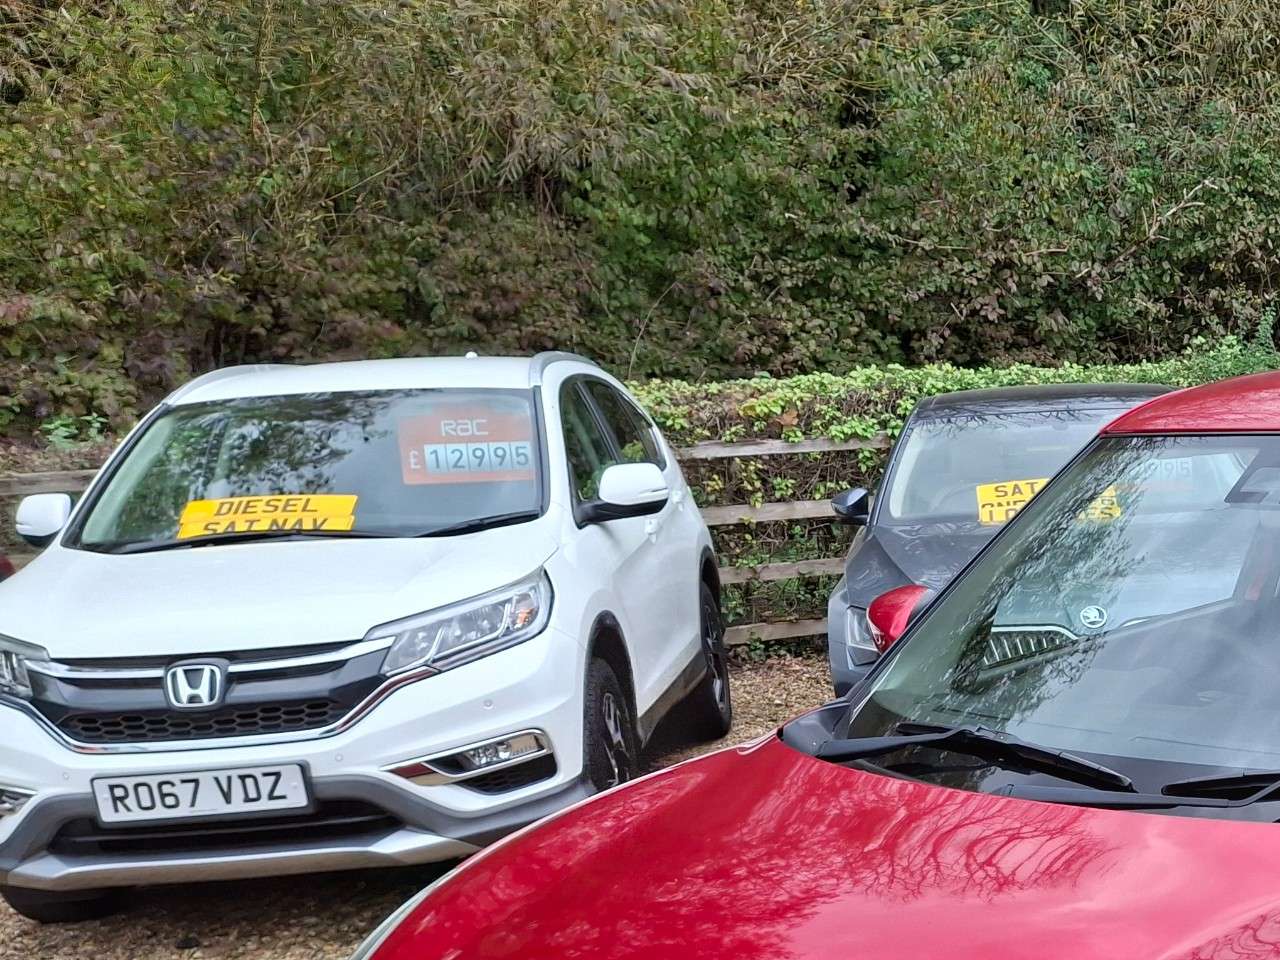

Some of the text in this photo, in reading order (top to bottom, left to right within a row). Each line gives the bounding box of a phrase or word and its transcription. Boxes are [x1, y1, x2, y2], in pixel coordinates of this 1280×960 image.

[993, 482, 1038, 498] SAT
[214, 498, 318, 517] DIESEL
[108, 771, 287, 813] RO67 VDZ
